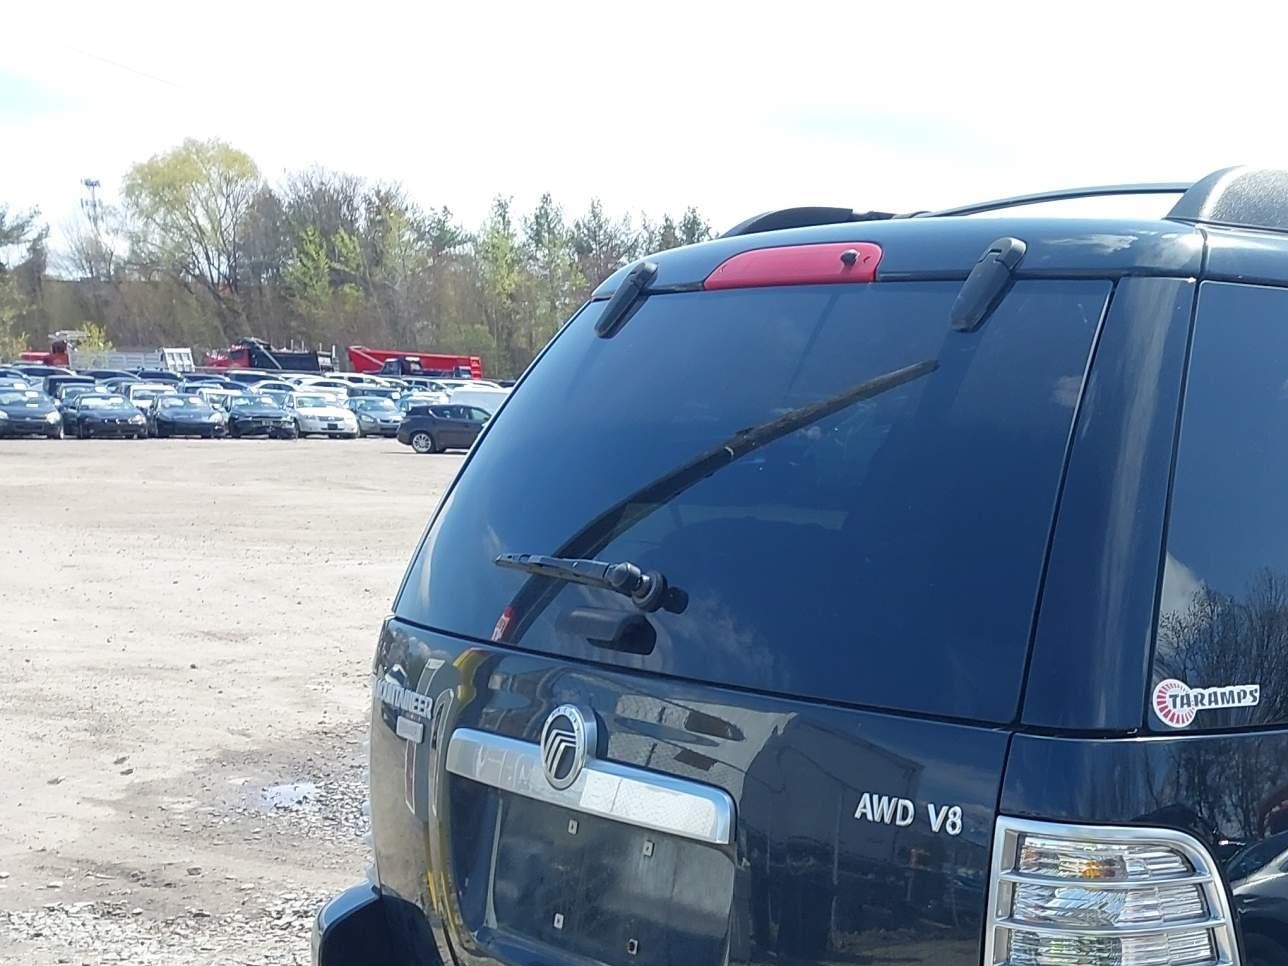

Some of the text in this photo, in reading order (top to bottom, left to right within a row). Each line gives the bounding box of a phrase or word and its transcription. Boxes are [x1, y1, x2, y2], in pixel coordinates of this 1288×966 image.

[1168, 688, 1259, 710] TARAMPS
[854, 792, 962, 836] AWD V8
